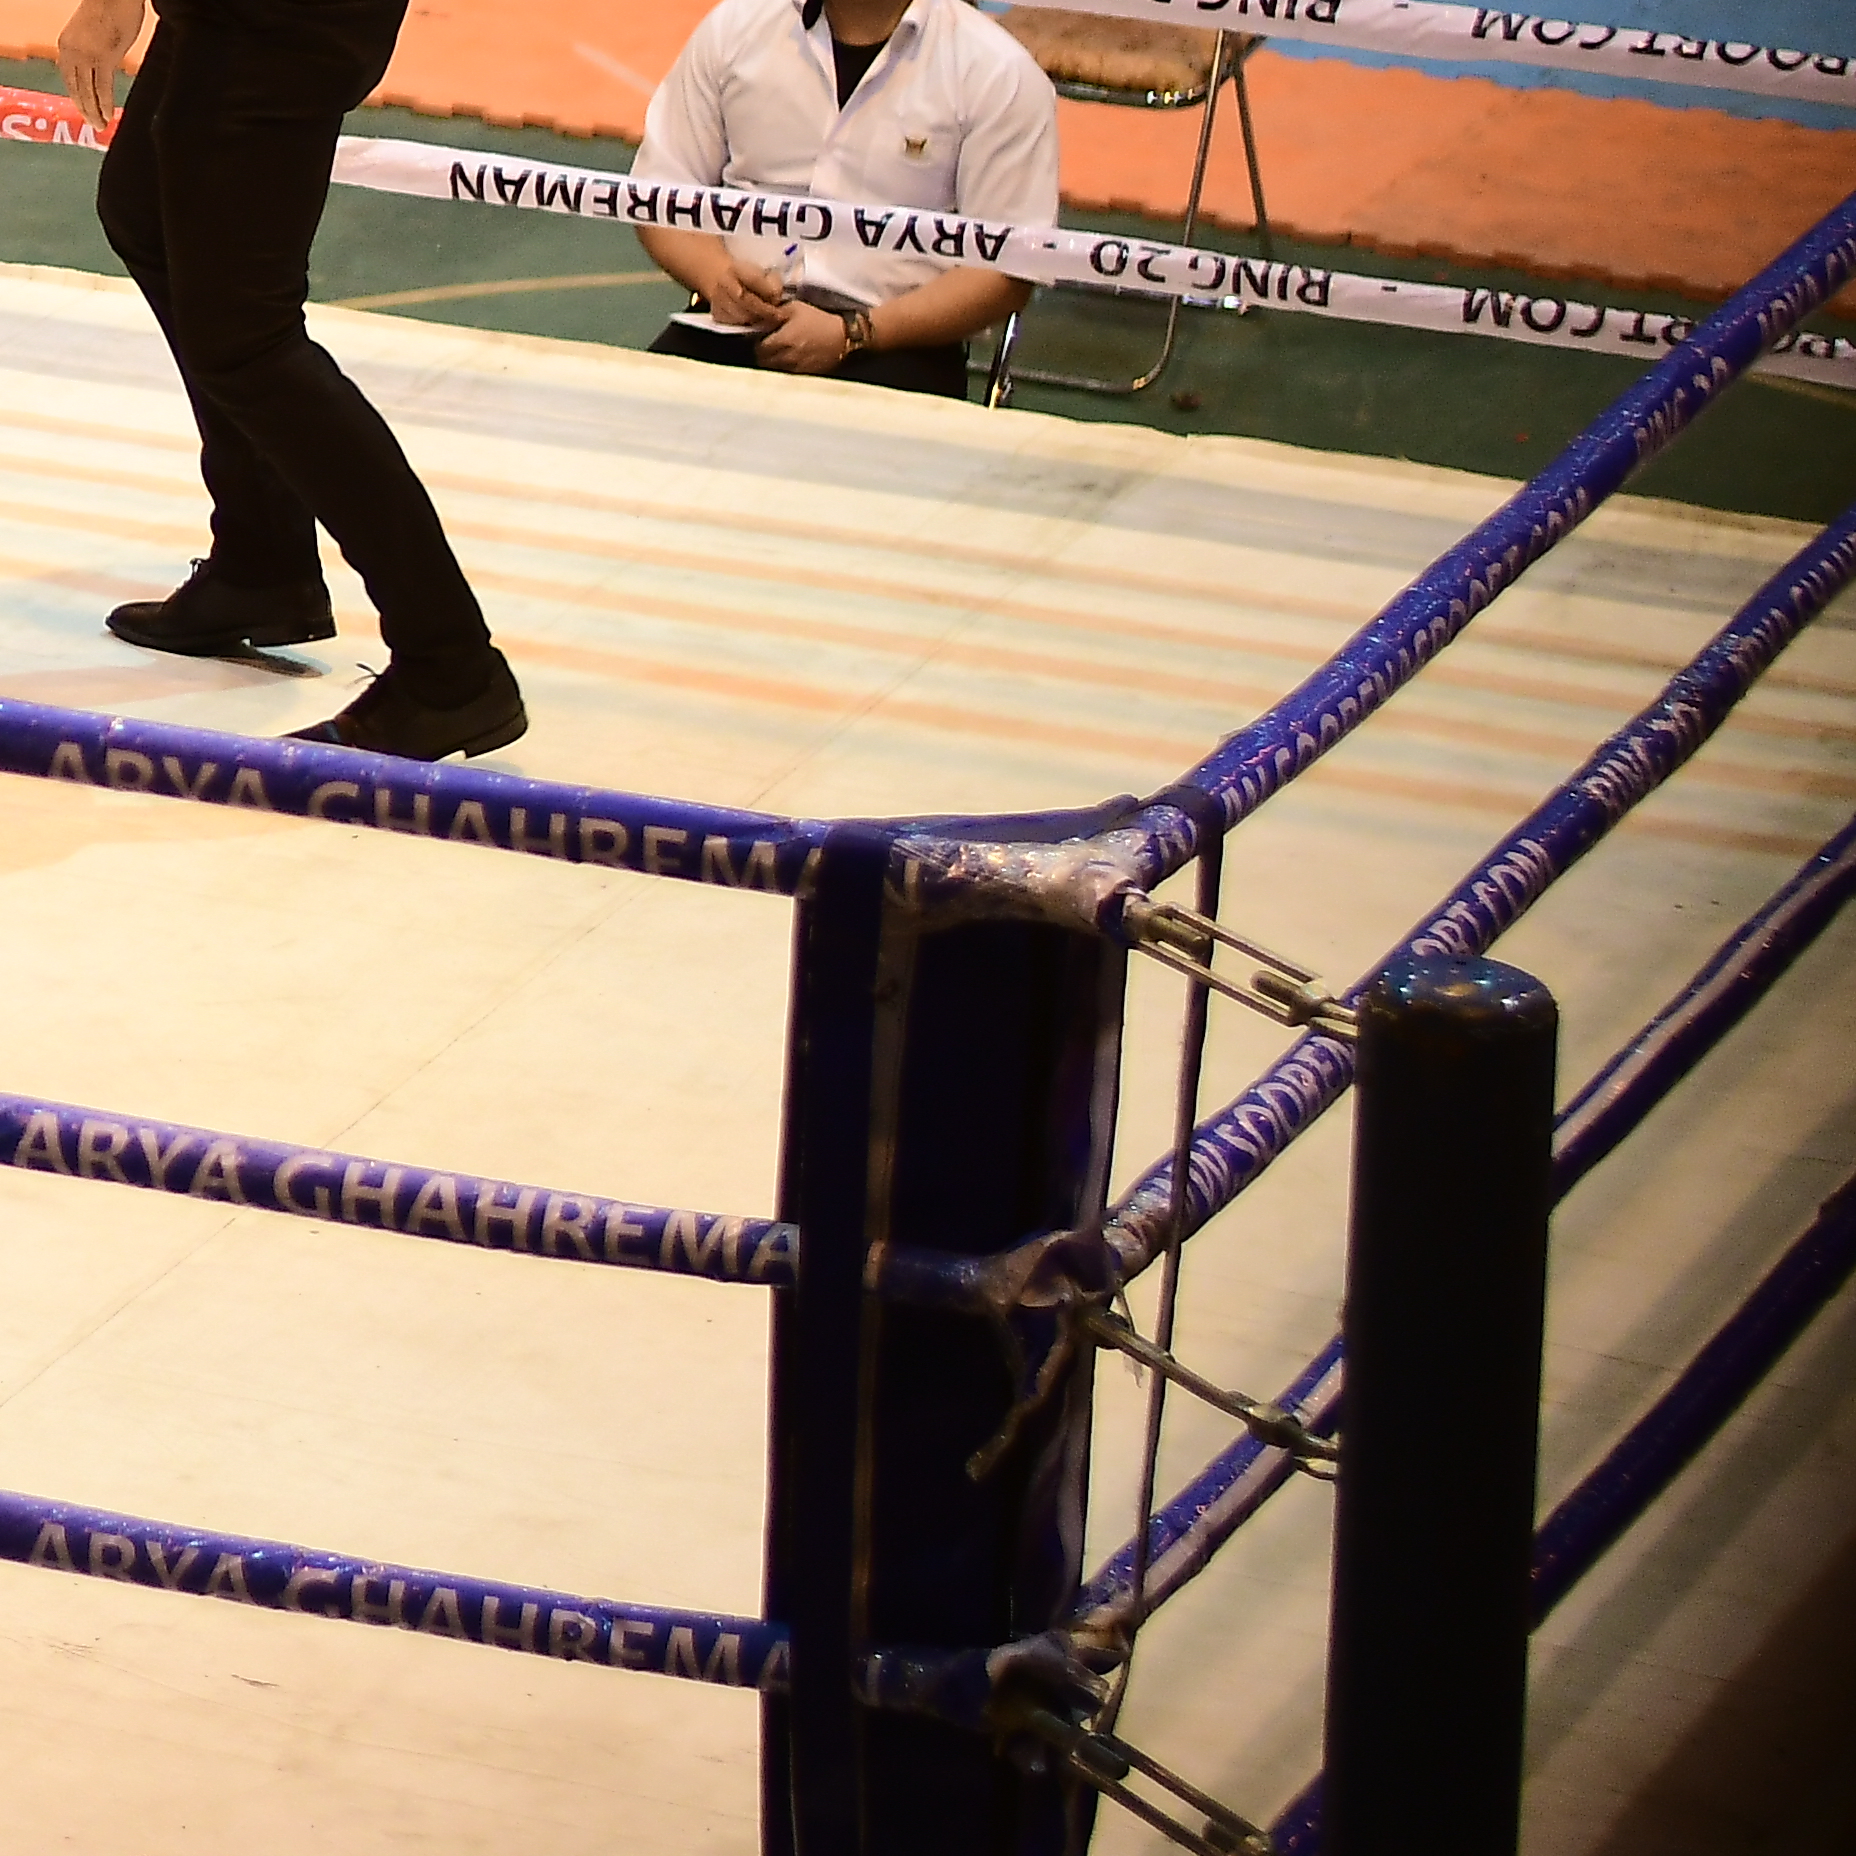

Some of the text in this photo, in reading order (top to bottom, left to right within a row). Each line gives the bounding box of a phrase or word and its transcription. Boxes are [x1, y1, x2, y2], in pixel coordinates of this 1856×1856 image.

[447, 158, 833, 243] GHAHREMAN
[853, 205, 1014, 264] ARYA
[1087, 239, 1173, 284] 20
[1186, 256, 1334, 308] RING
[12, 1110, 249, 1205] ARYA
[29, 1520, 259, 1603] ARYA
